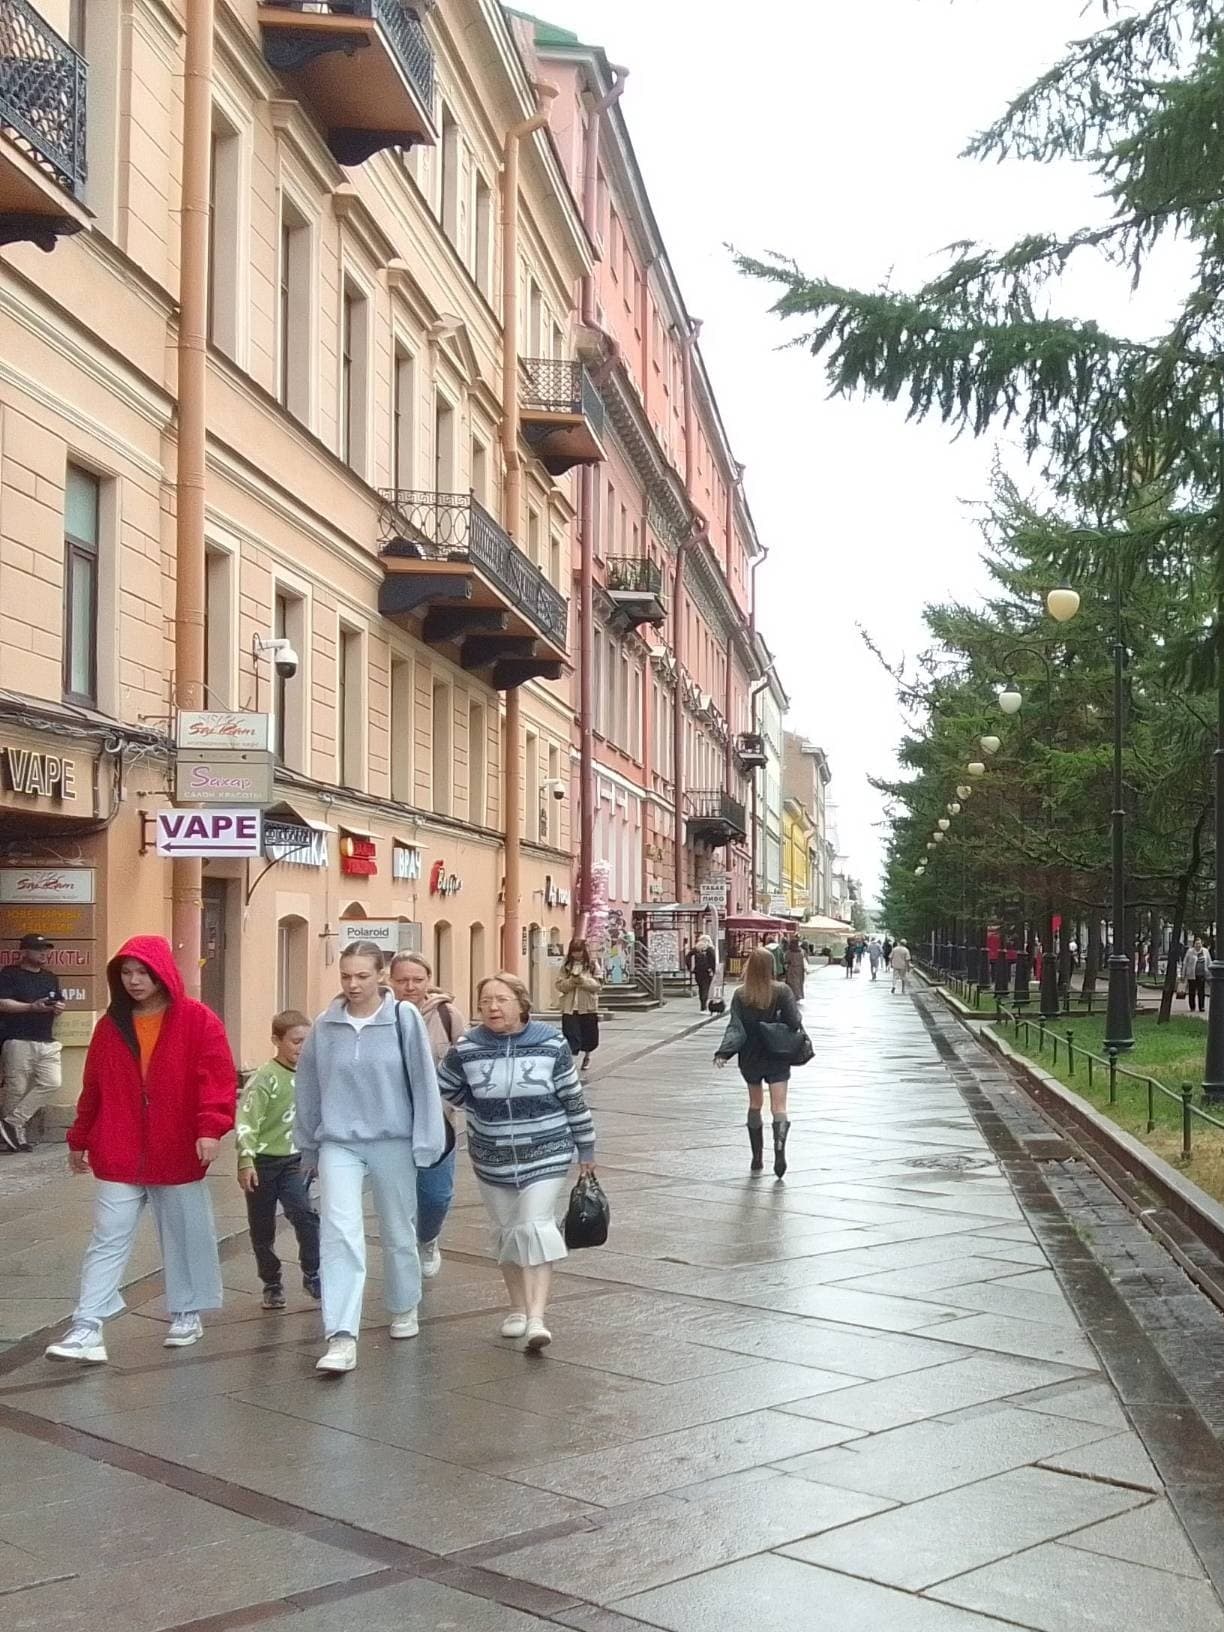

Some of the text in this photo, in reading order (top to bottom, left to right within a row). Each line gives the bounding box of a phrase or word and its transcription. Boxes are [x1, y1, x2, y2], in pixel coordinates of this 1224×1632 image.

[8, 746, 77, 800] VAPE
[159, 815, 256, 839] VAPE
[347, 927, 389, 936] Polaroid
[1, 950, 90, 966] ПРУКТЫ
